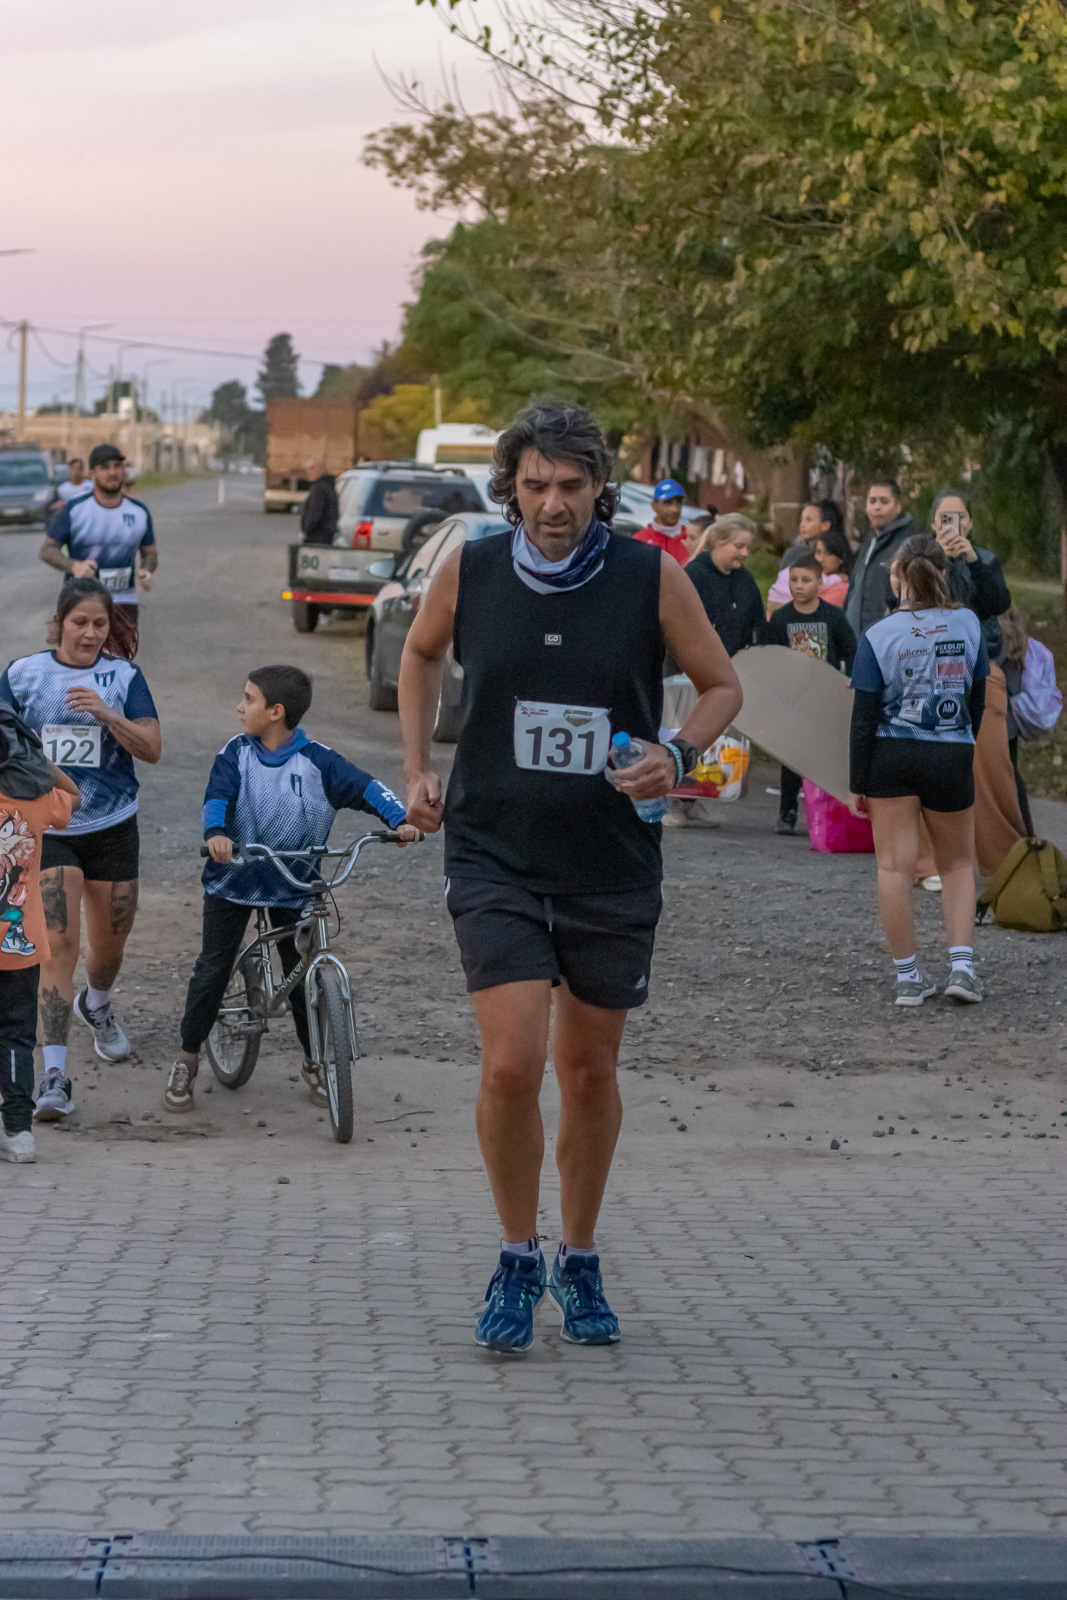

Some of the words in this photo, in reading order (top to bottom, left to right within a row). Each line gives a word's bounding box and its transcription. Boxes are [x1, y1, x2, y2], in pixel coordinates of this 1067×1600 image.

[935, 643, 965, 651] FEEDLOT
[942, 702, 955, 713] AM
[46, 739, 95, 765] 122
[525, 726, 595, 769] 131
